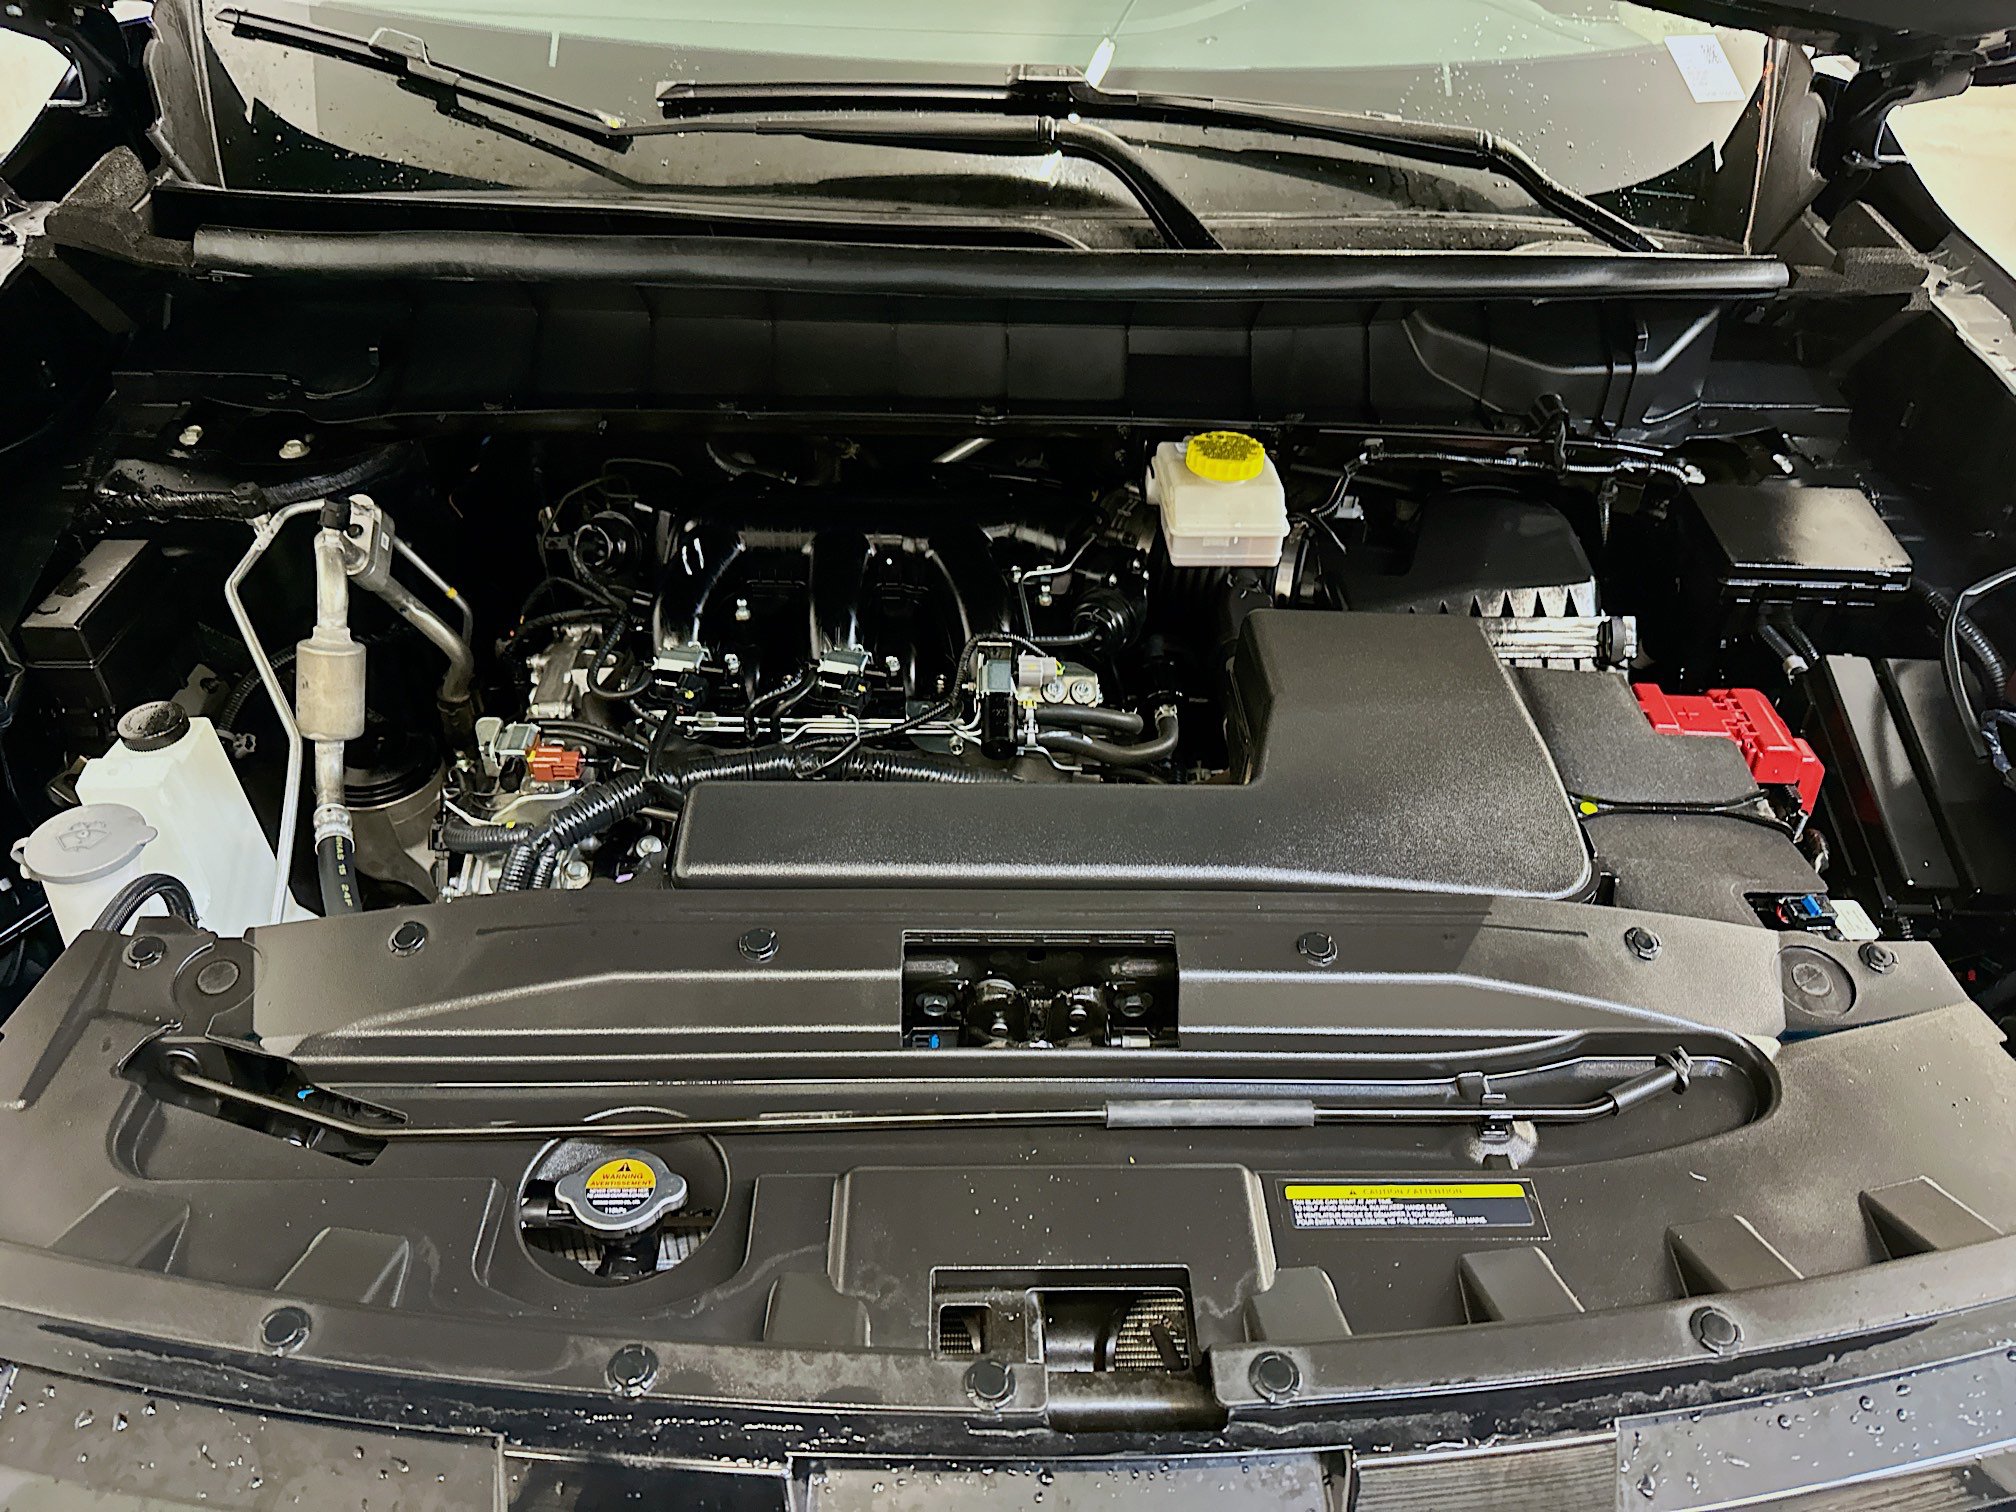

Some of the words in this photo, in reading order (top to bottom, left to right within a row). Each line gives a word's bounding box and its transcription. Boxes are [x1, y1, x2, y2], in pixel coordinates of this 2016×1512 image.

[341, 884, 352, 906] 24F
[1363, 1187, 1404, 1196] CAUTION
[1412, 1187, 1463, 1196] ATTENTION
